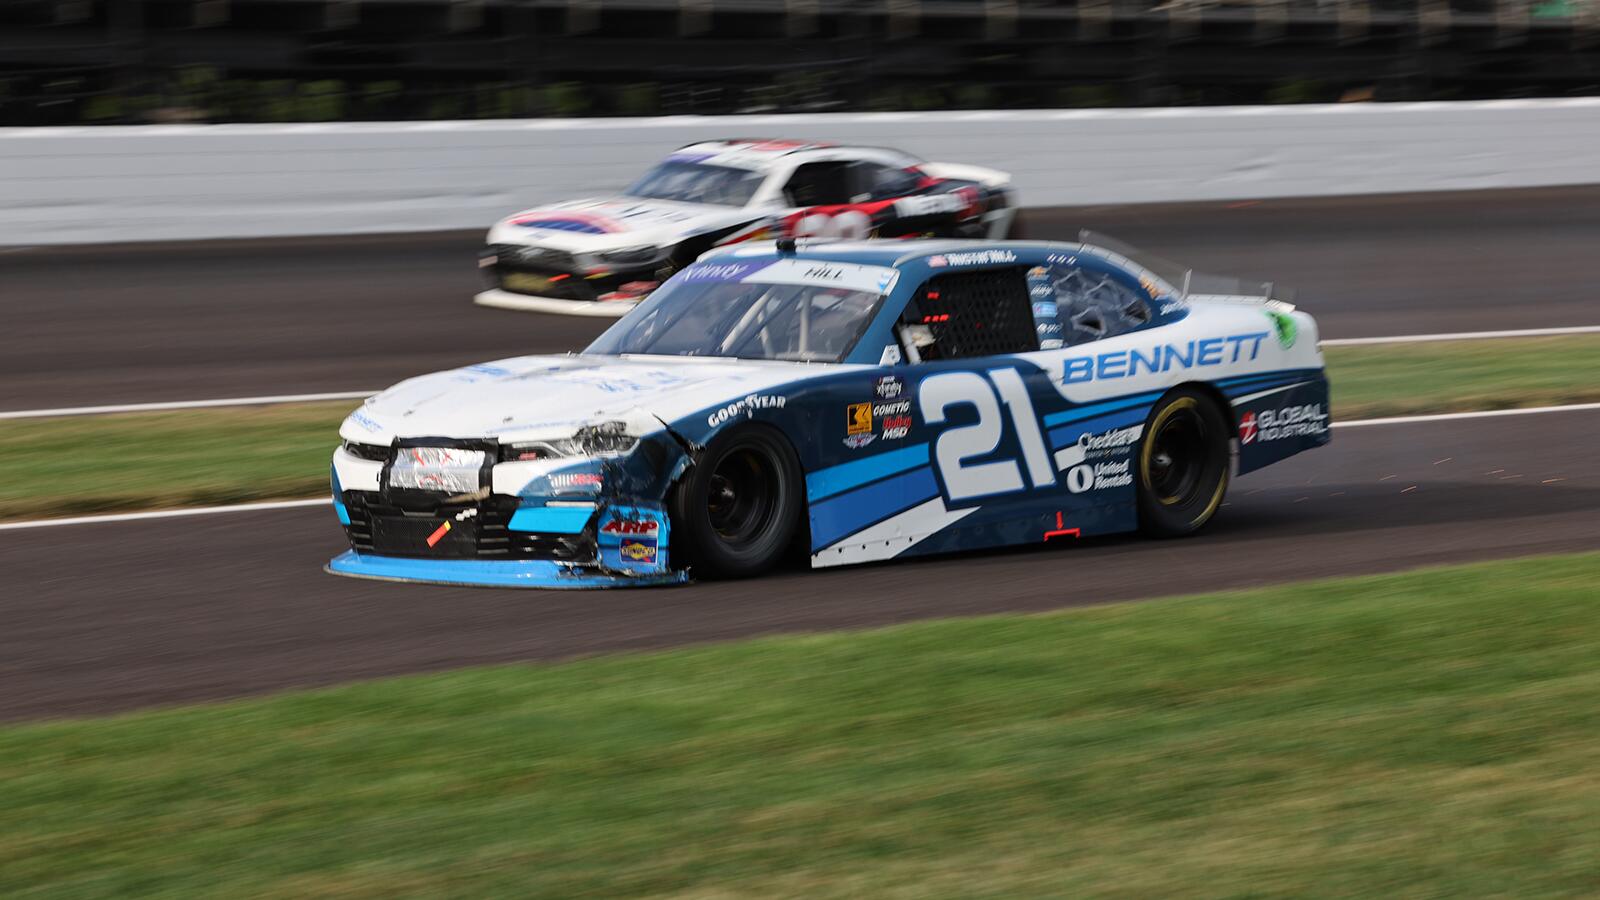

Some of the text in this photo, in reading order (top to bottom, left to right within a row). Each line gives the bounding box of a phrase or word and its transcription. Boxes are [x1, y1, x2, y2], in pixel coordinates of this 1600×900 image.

[803, 266, 845, 280] HILL
[1061, 331, 1269, 385] BENNETT
[707, 393, 786, 428] GOODYEAR
[873, 400, 910, 416] COMETIC
[1257, 403, 1328, 429] GLOBAL
[881, 426, 909, 440] MSD
[919, 365, 1056, 501] 21
[1257, 421, 1328, 442] INDUSTRIAL
[1094, 459, 1130, 477] United
[1093, 472, 1133, 490] Rentals
[601, 519, 659, 535] ARP
